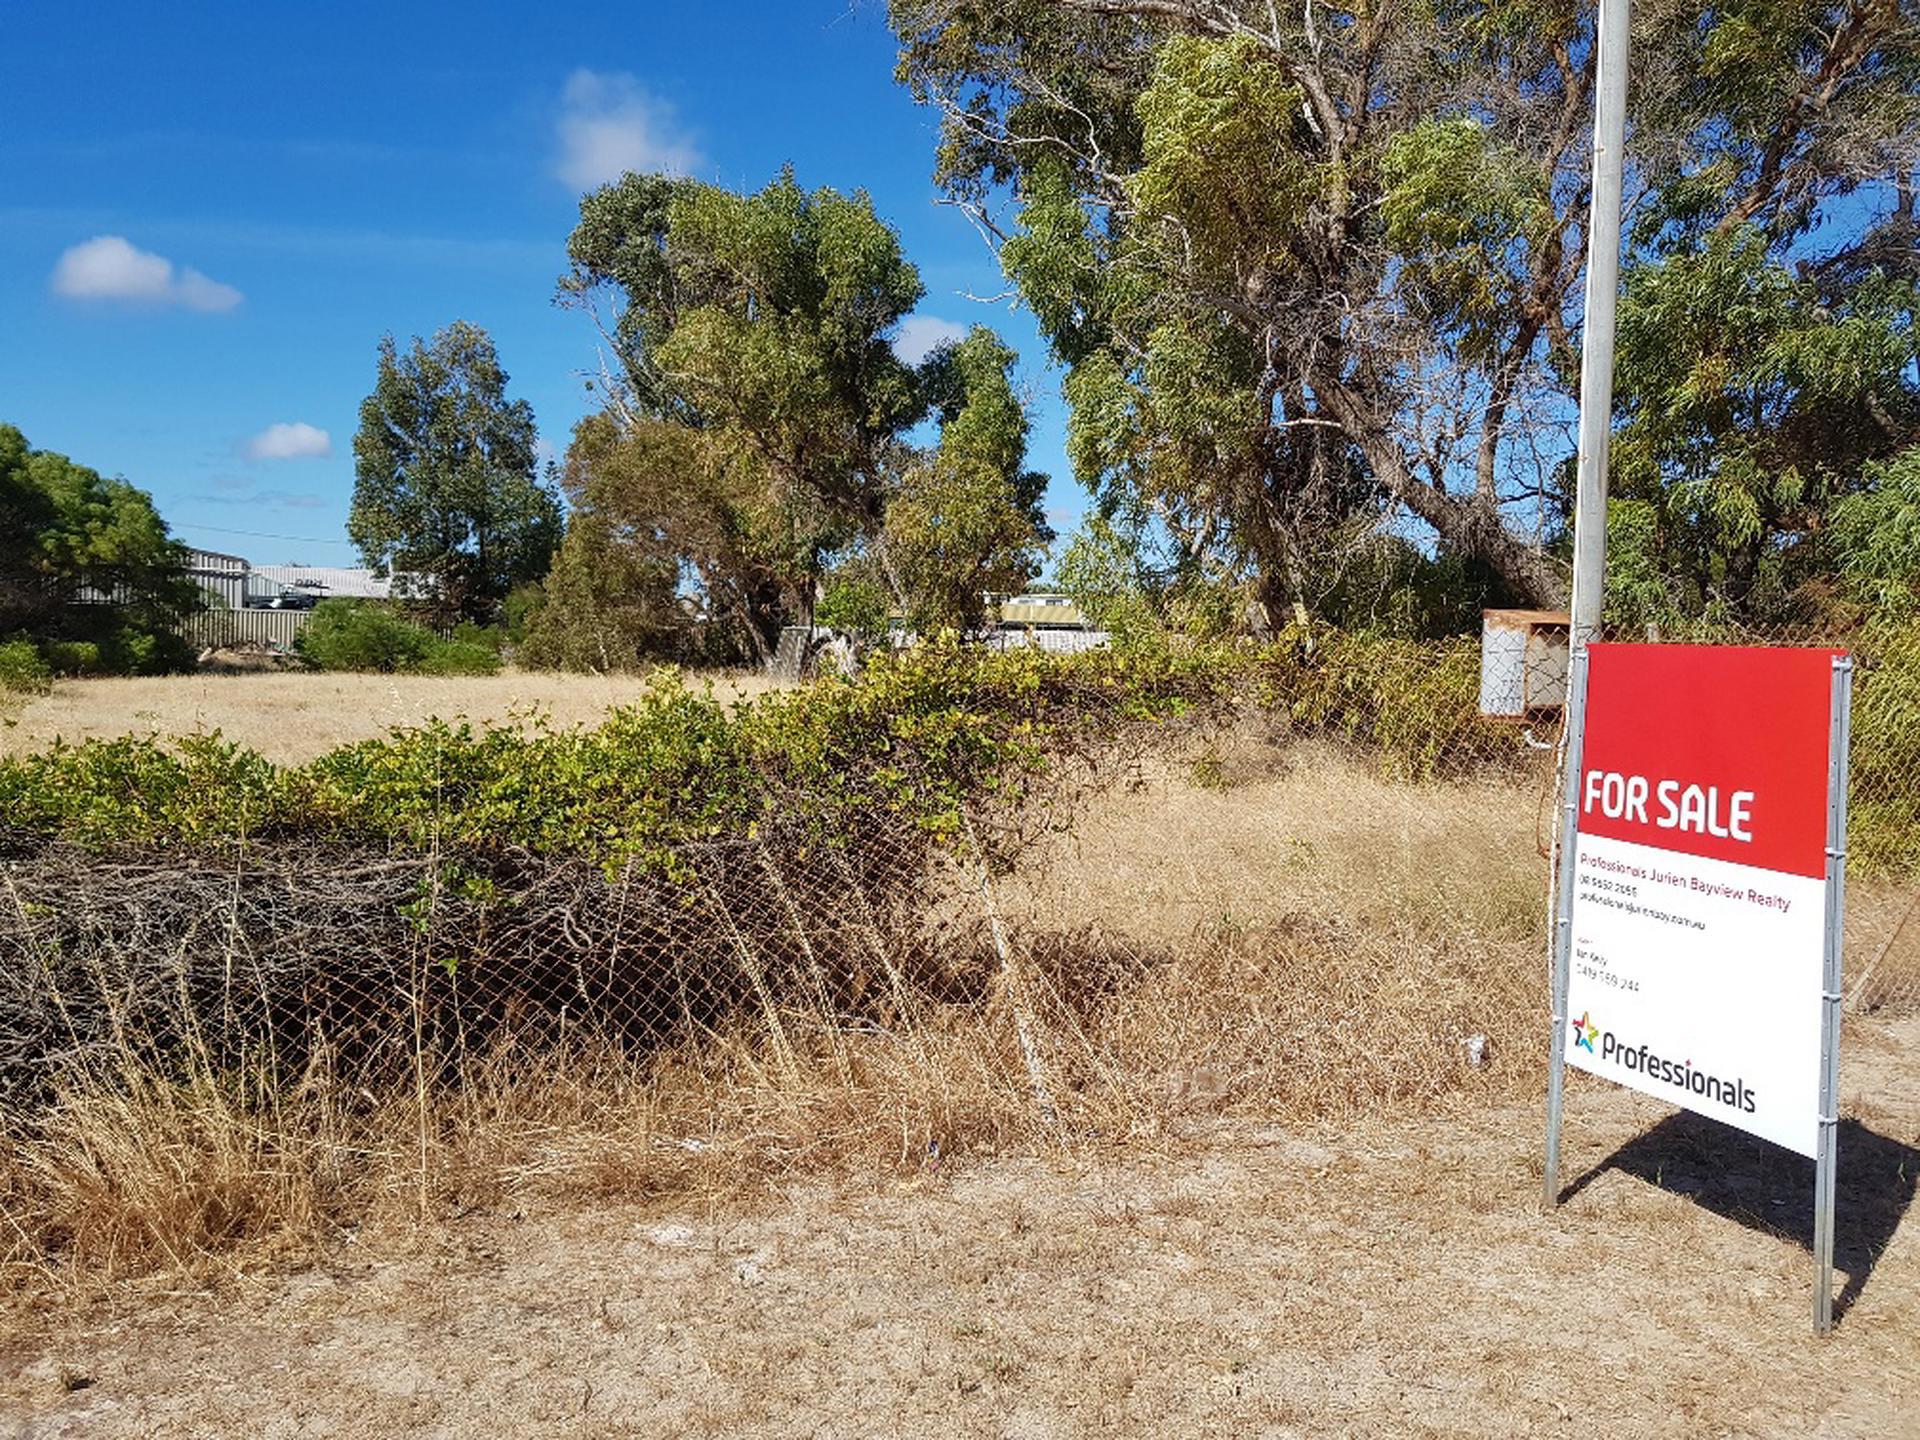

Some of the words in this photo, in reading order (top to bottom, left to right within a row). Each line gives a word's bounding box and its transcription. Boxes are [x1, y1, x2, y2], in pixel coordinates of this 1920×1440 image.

[1584, 770, 1648, 824] FOR
[1657, 780, 1755, 843] SALE
[1580, 853, 1647, 880] Professionals
[1649, 868, 1687, 888] Jurien
[1690, 877, 1744, 900] Bayview
[1748, 889, 1792, 913] Realty
[1602, 1031, 1756, 1114] Professionals
